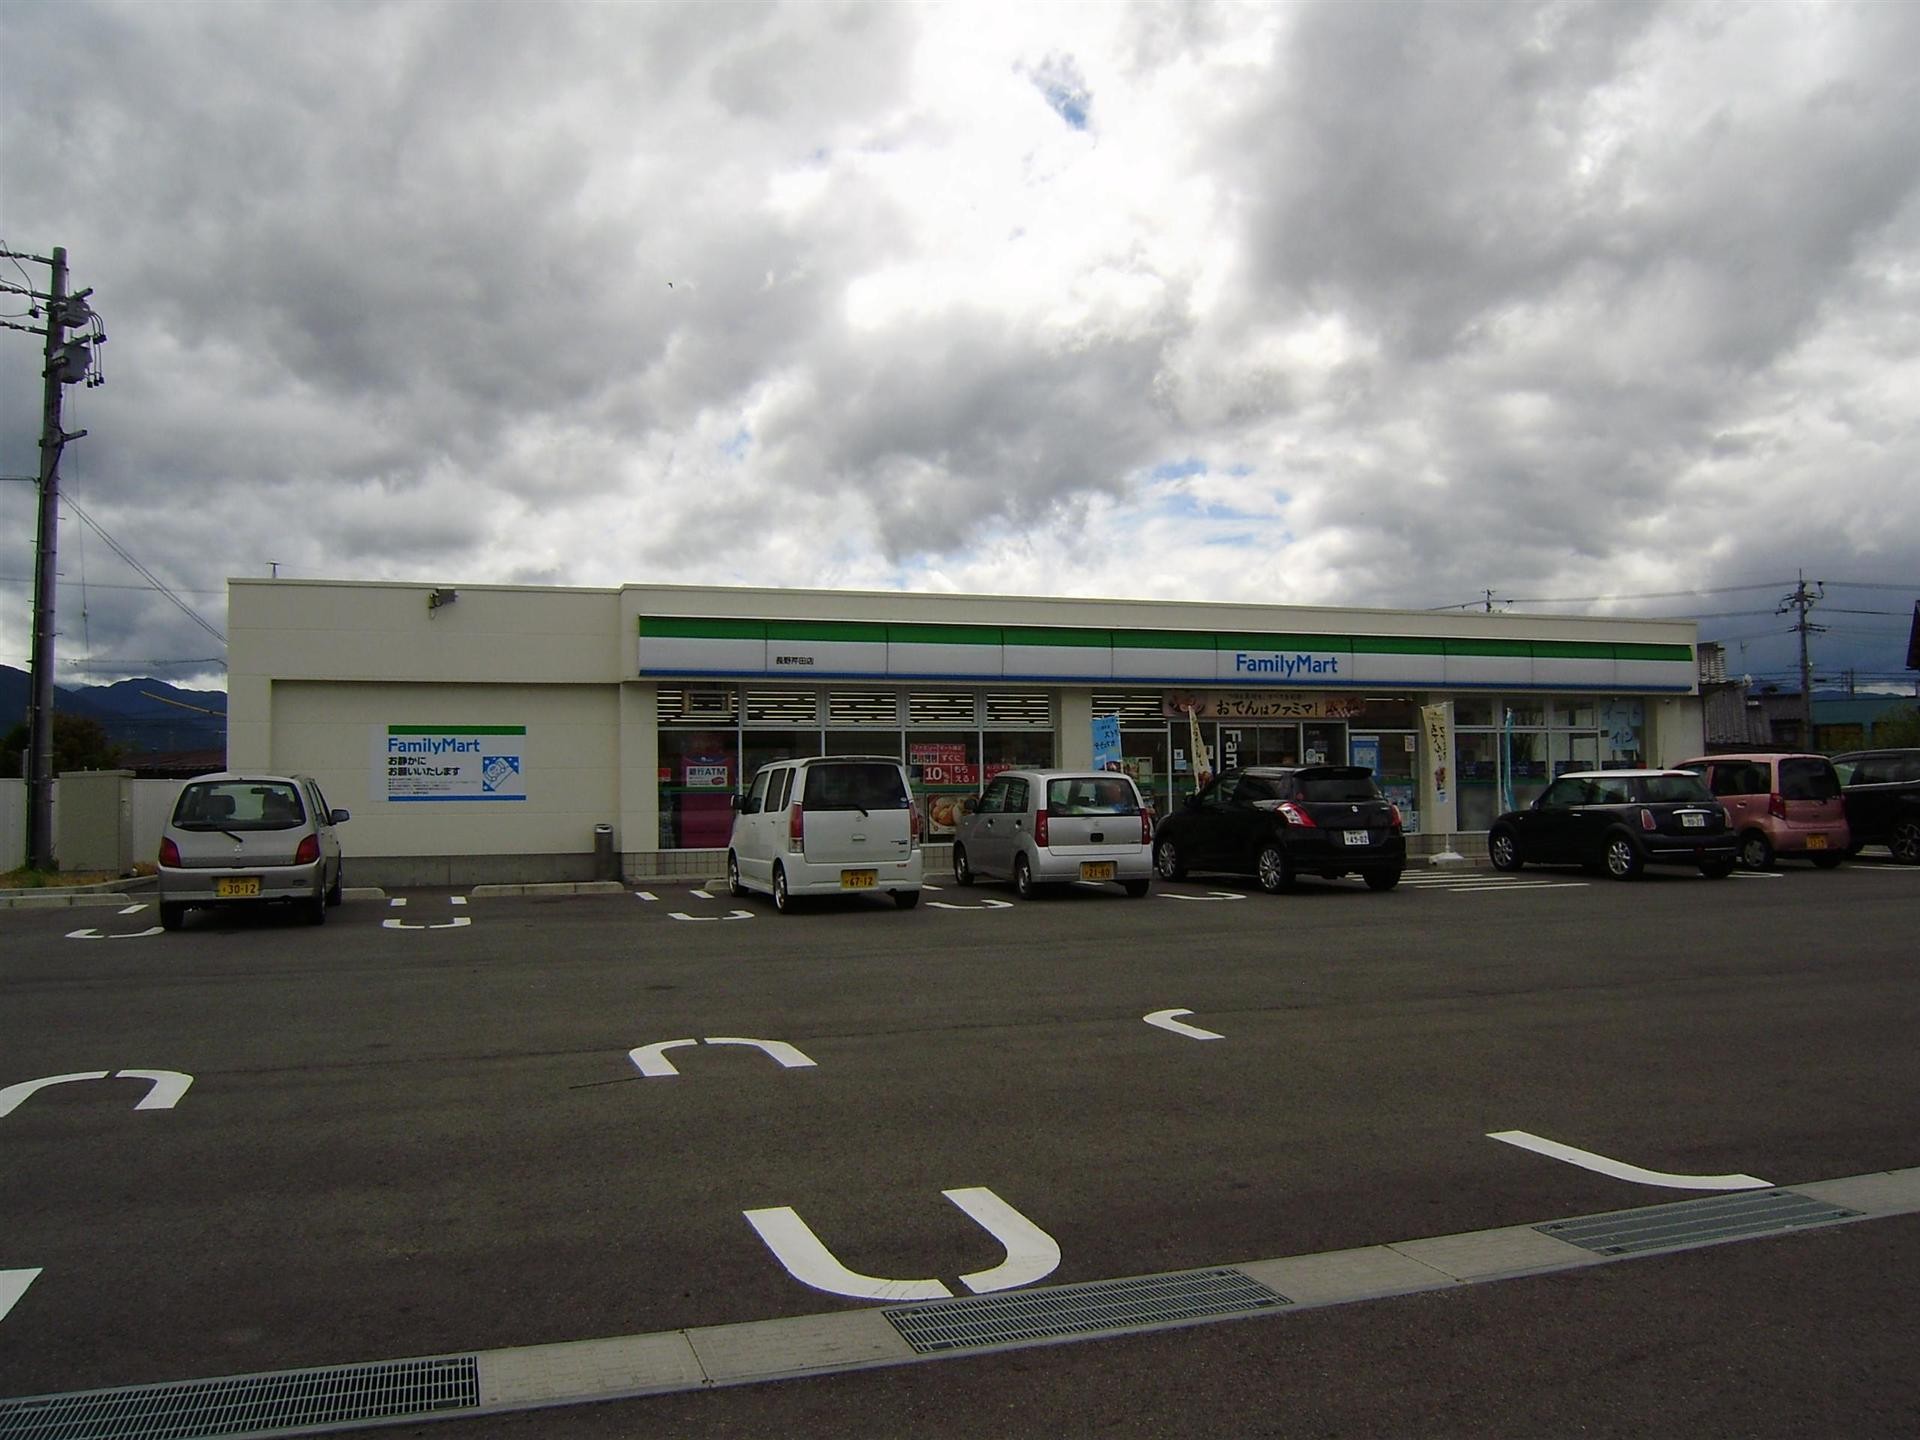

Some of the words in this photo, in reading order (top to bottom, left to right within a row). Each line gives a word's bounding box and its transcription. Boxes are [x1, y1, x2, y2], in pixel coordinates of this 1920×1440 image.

[1236, 654, 1338, 677] FamilyMart
[1216, 700, 1318, 716] おでんはファミマ!
[388, 738, 480, 754] FamilyMart
[388, 757, 426, 766] お静かに
[388, 767, 460, 776] お願いいたします
[925, 767, 942, 780] 10
[228, 884, 256, 894] 30-12
